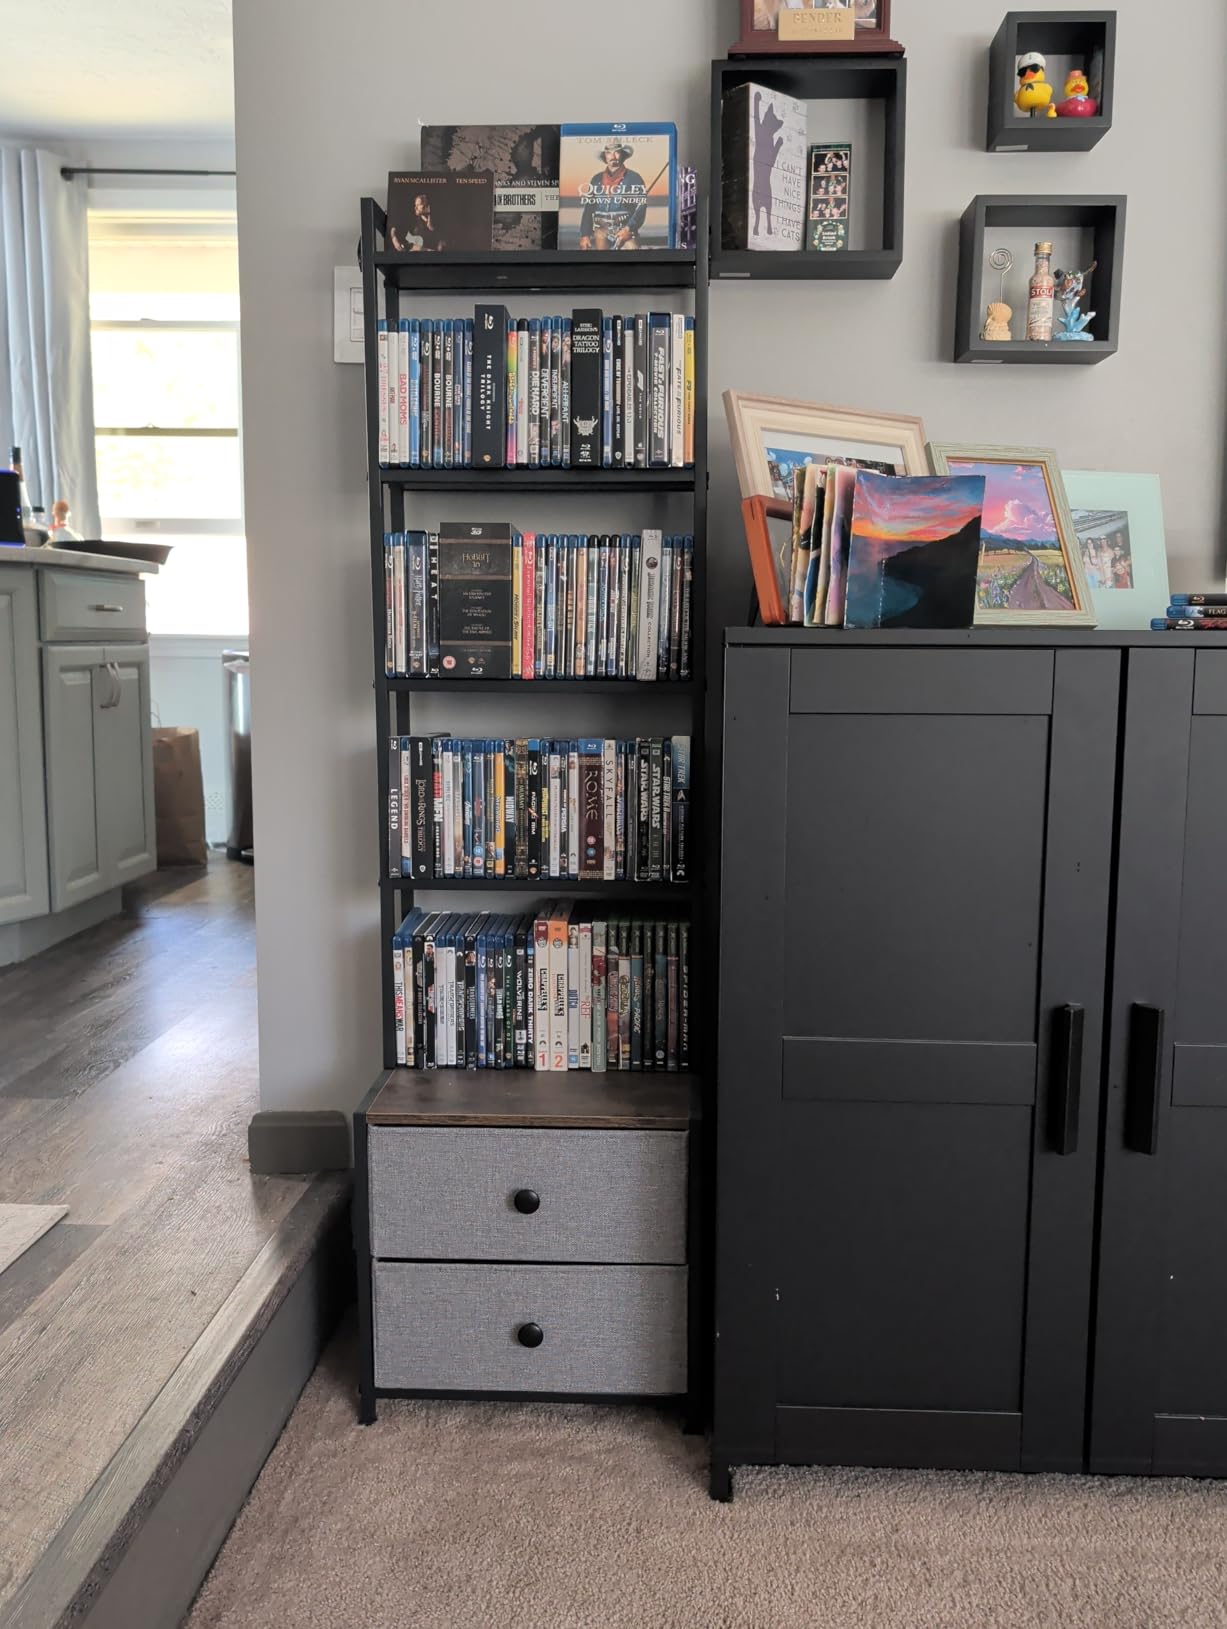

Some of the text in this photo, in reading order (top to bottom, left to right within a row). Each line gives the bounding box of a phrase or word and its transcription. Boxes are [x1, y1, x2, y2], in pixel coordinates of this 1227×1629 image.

[578, 183, 648, 198] QUIGLEY
[783, 174, 801, 188] HAVE
[503, 194, 536, 206] BROTHERS
[581, 196, 647, 205] DOWN UNDER
[775, 198, 802, 214] THINGS
[784, 187, 801, 201] NICE
[781, 228, 801, 242] CATS
[532, 371, 540, 386] DIE
[532, 387, 540, 415] HARD
[541, 368, 549, 419] DIVERGENT
[430, 557, 438, 601] HEAT
[652, 764, 661, 797] STAR
[663, 776, 671, 792] STAR
[677, 765, 686, 784] TREK
[416, 780, 427, 798] LORD
[584, 770, 598, 820] ROME
[605, 760, 614, 819] SKYFALL
[640, 760, 649, 822] STAR WARS
[663, 791, 671, 807] TREK
[390, 789, 398, 830] LEGEND
[416, 802, 426, 826] RINGS
[505, 796, 514, 823] MIDWAY
[652, 795, 661, 829] WARS
[538, 968, 548, 1011] CHAPPELLE'S
[619, 974, 629, 1016] GODZILLA
[394, 995, 403, 1020] MEANS
[581, 1000, 591, 1018] REF
[555, 974, 565, 1068] CHAPPELLE'S 2
[633, 1007, 641, 1034] PACIFIC
